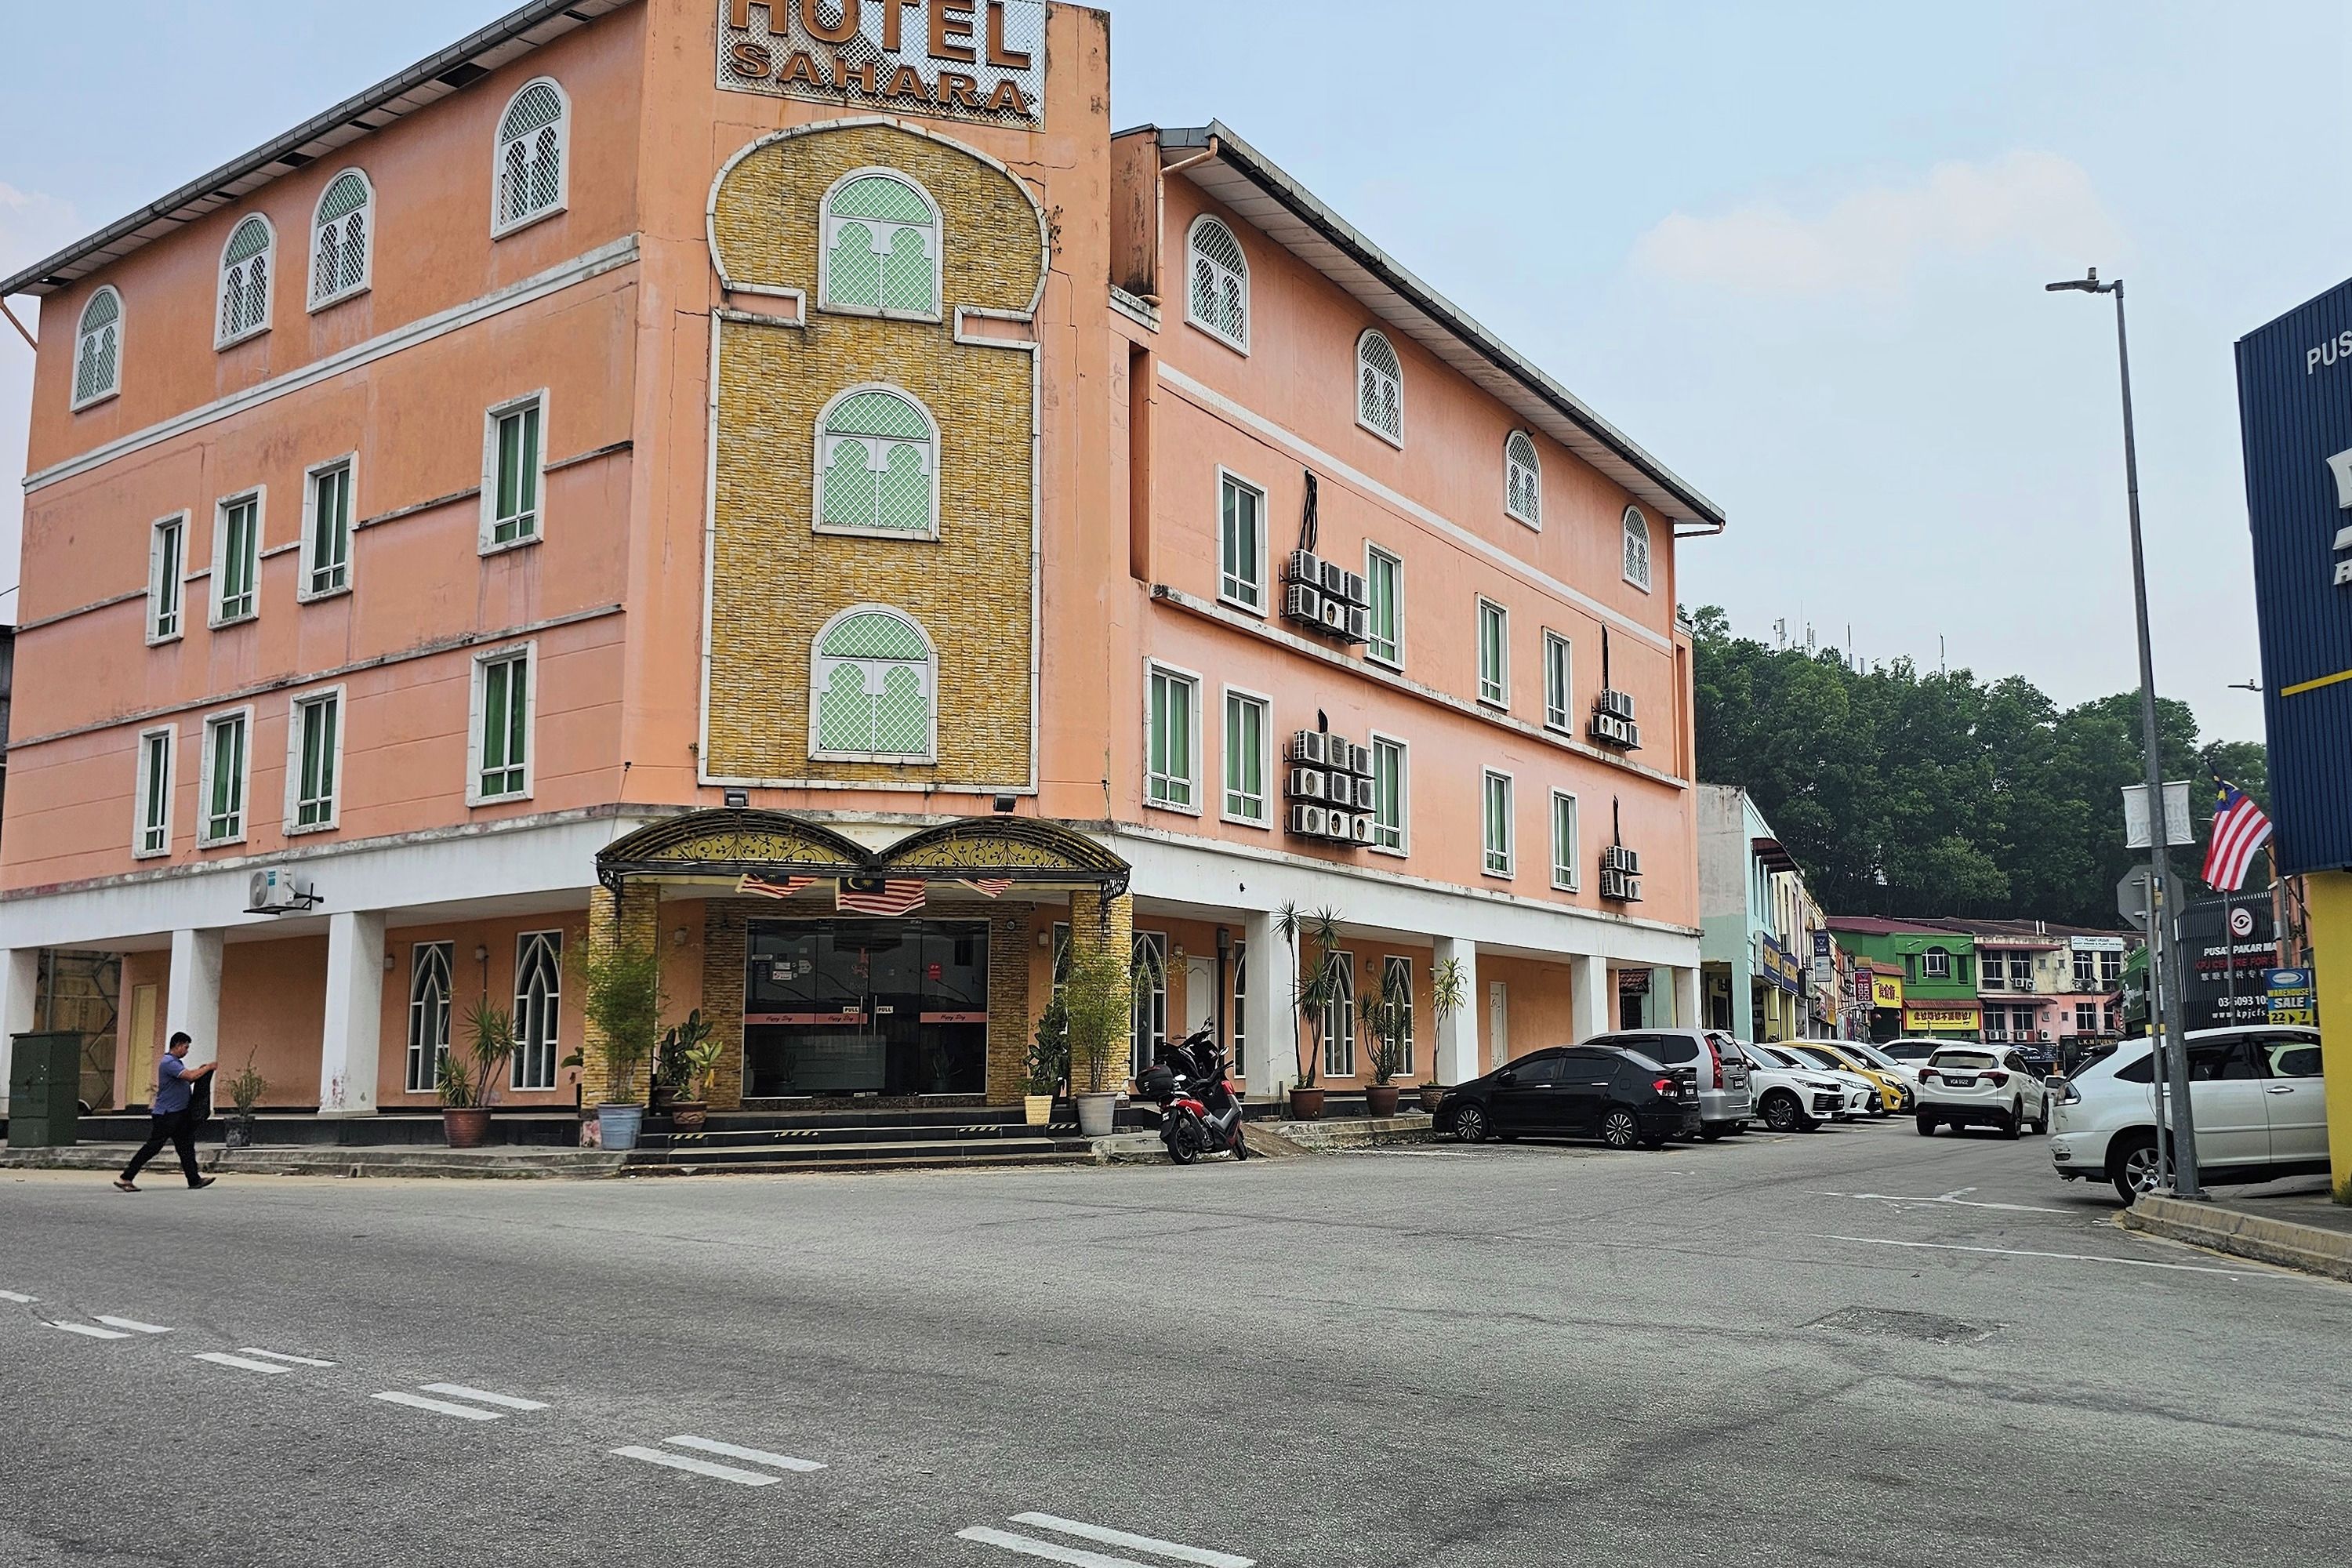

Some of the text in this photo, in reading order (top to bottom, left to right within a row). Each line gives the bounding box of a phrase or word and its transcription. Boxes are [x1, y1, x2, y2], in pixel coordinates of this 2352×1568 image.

[730, 42, 1031, 115] SAHARA
[2233, 943, 2263, 954] PAKAR
[2274, 996, 2305, 1008] SALE
[2271, 1010, 2307, 1022] 22 7
